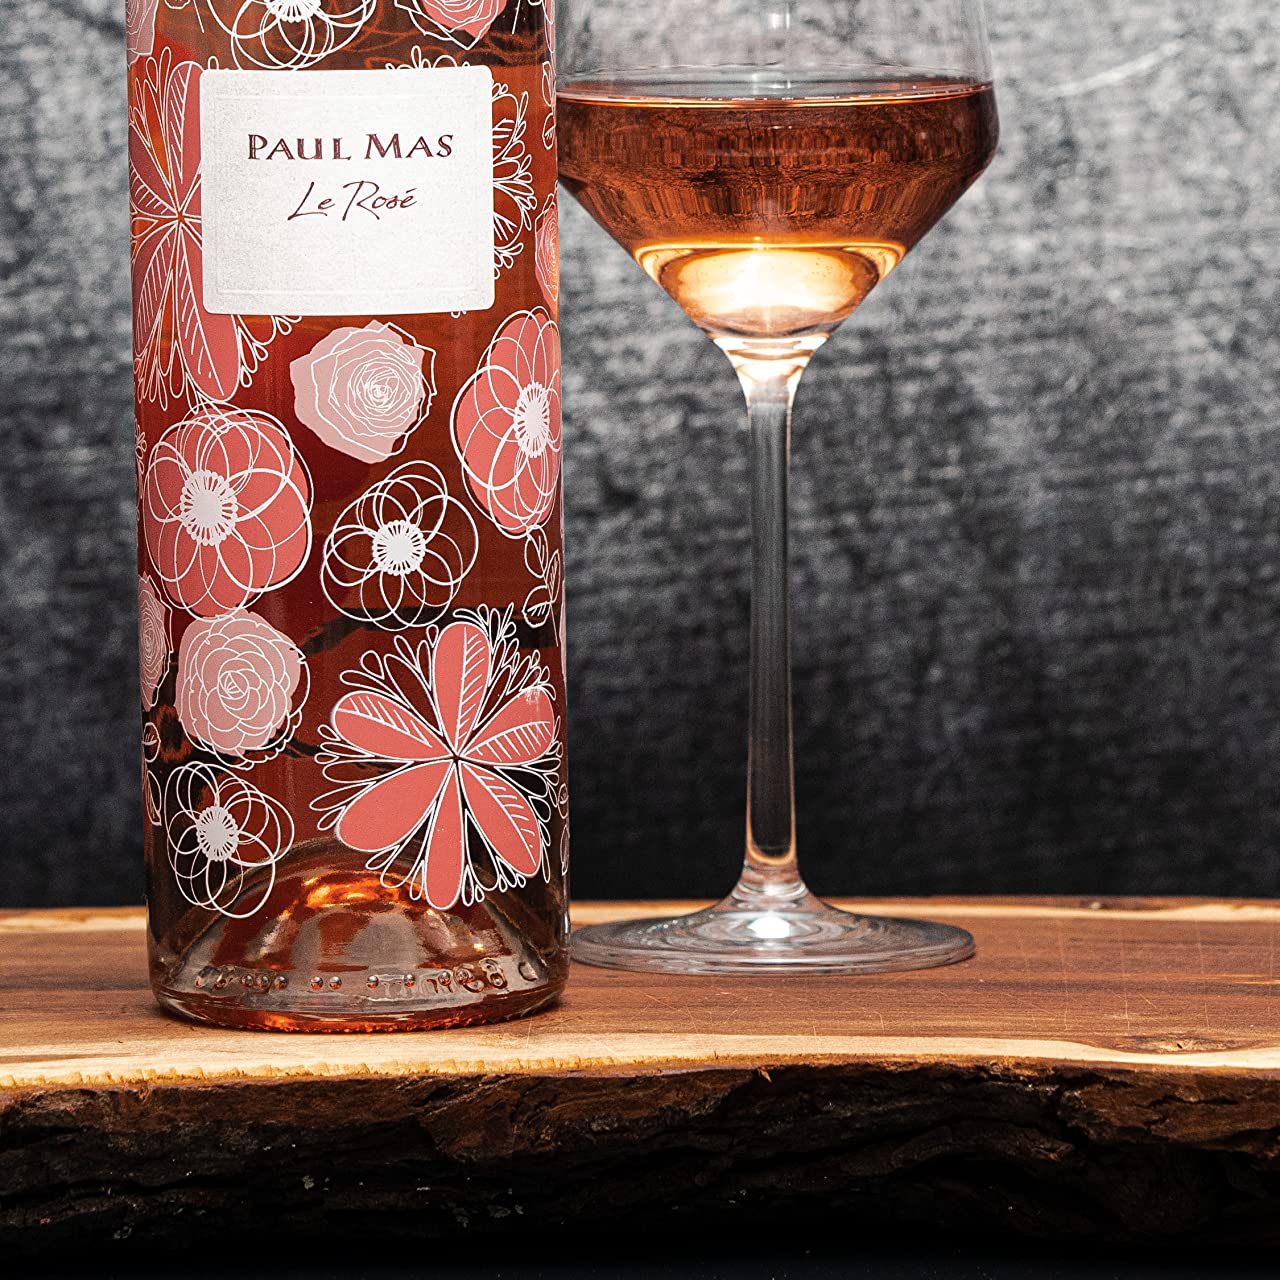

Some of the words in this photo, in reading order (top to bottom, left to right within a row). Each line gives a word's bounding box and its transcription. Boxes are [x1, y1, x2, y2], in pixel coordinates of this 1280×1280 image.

[247, 133, 351, 160] PAUL
[364, 133, 454, 160] MAS
[287, 181, 335, 221] Le
[342, 180, 418, 221] Rosé
